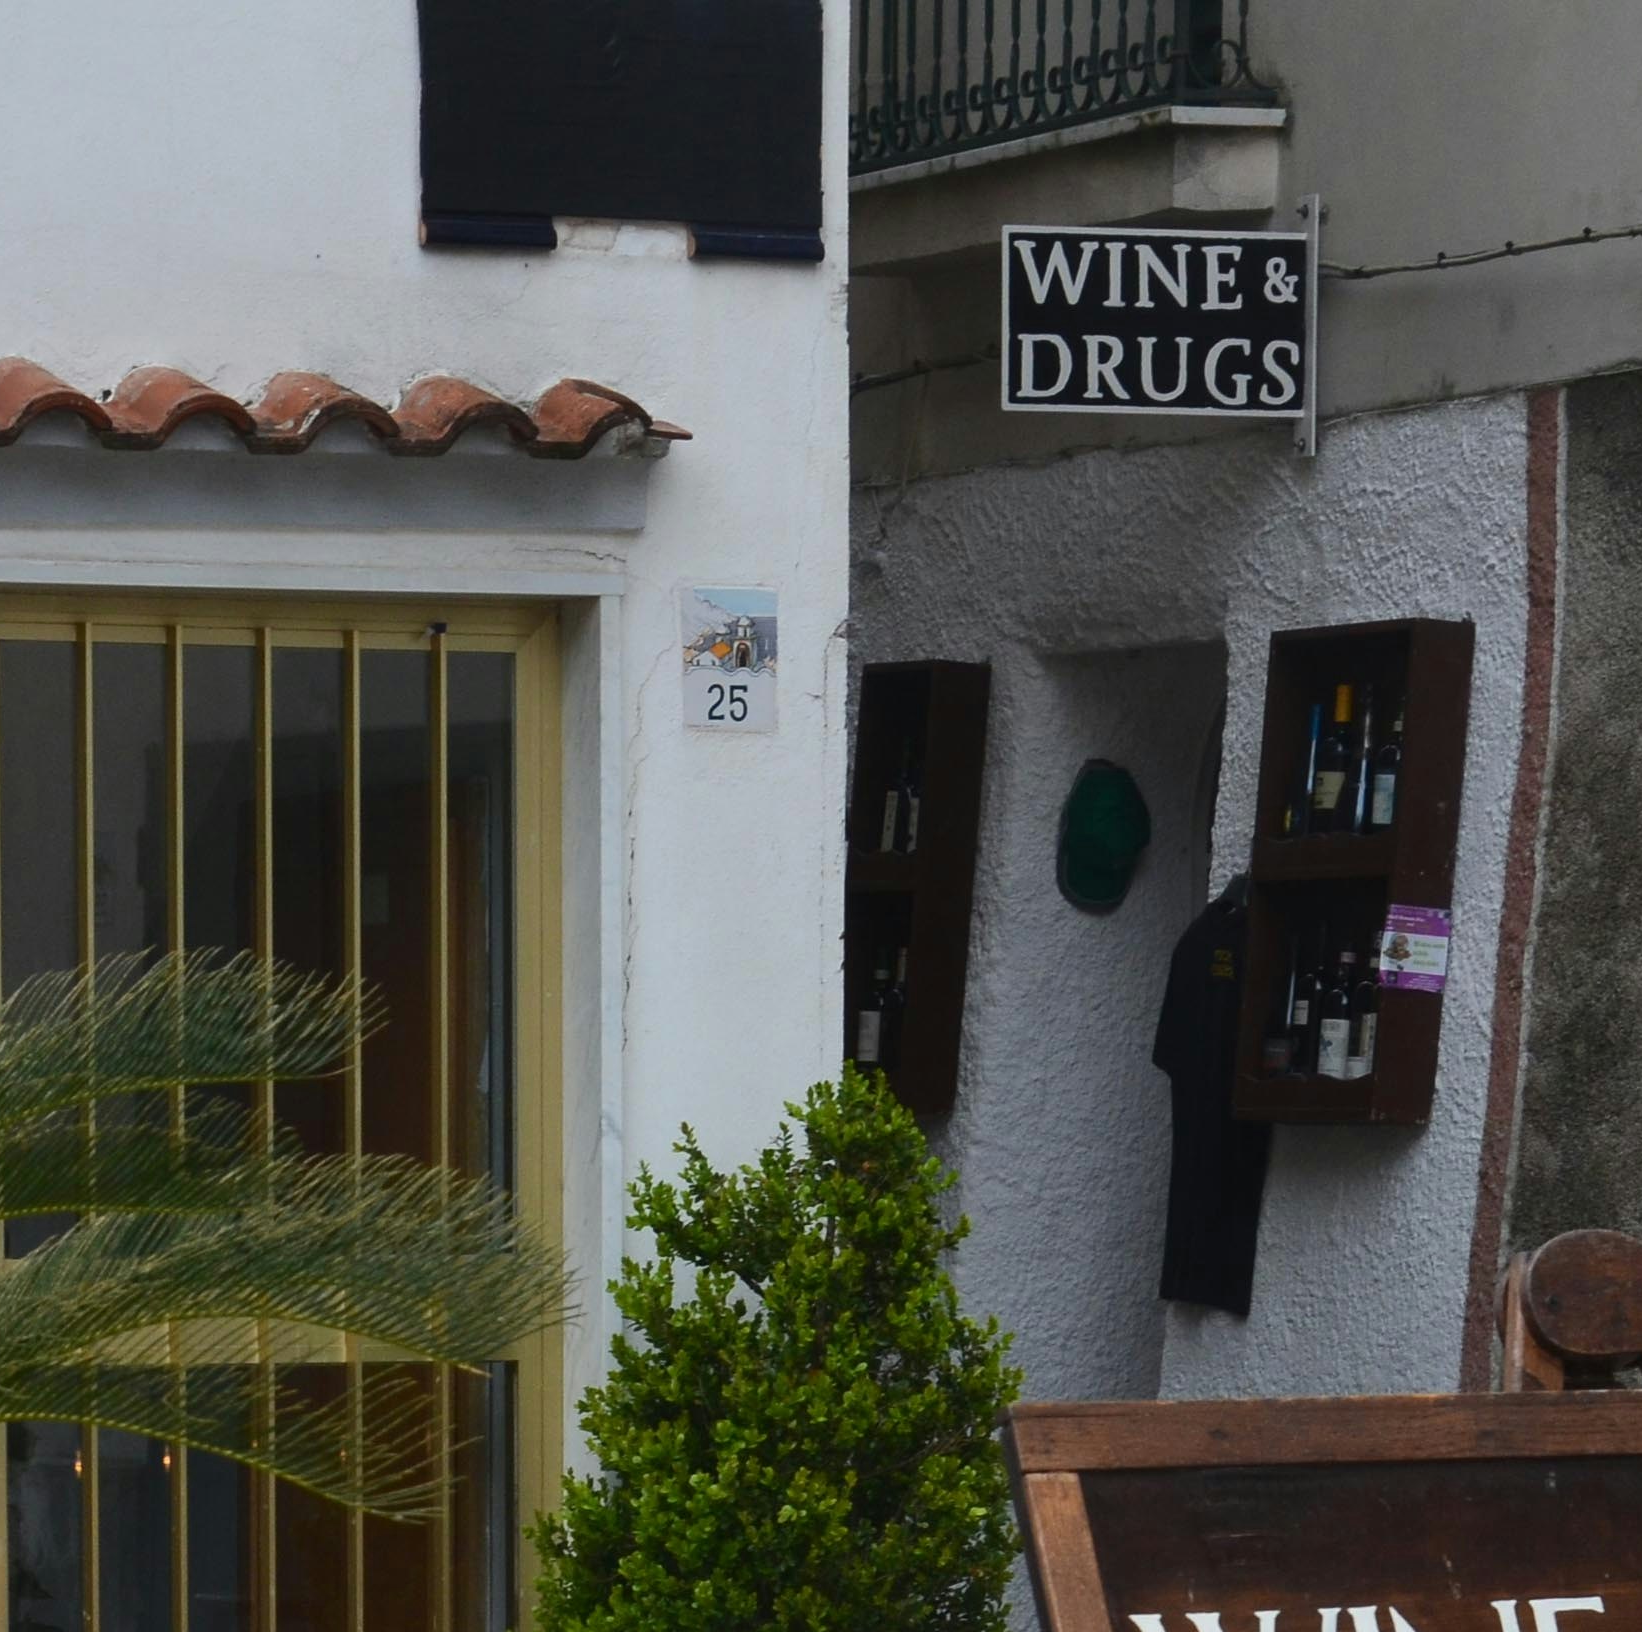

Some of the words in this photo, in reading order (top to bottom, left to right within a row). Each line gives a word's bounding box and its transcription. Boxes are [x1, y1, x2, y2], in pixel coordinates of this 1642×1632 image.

[1013, 239, 1243, 310] WINE
[1263, 257, 1299, 303] &
[1016, 333, 1300, 405] DRUGS
[707, 683, 748, 722] 25
